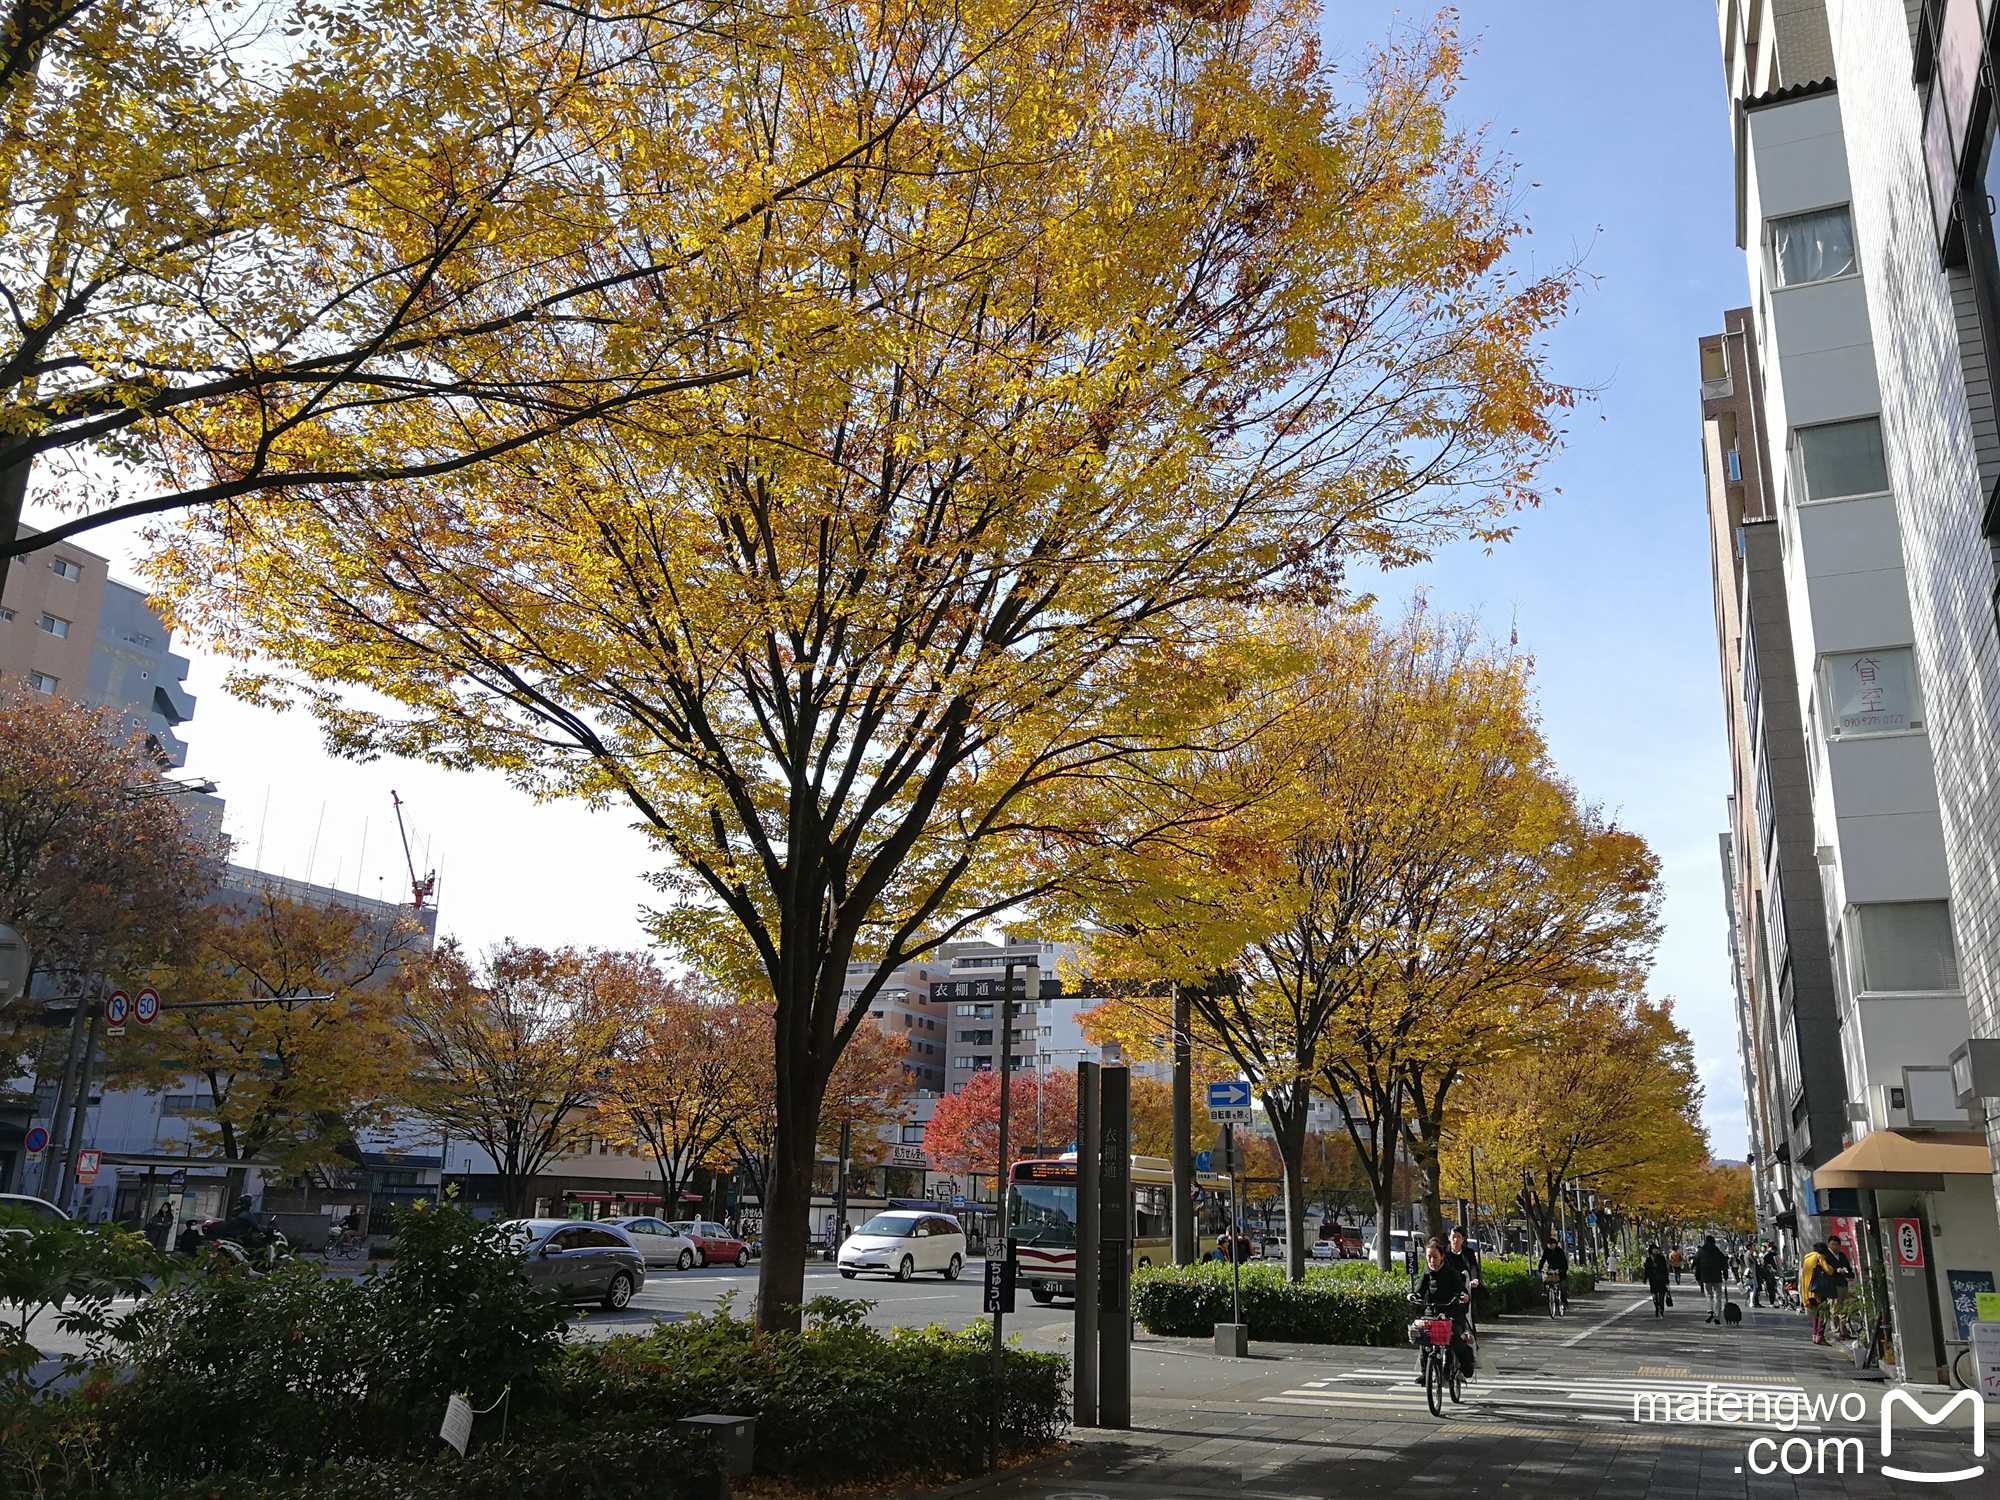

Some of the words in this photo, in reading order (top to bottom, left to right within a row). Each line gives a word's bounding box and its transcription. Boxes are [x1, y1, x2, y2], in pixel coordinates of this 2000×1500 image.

[1850, 657, 1885, 713] 貸室
[140, 998, 154, 1014] 50
[935, 982, 989, 996] 衣棚通
[1210, 1109, 1249, 1120] 自転車を除く
[1104, 1127, 1117, 1178] 衣棚通
[1902, 1225, 1915, 1260] たばこ
[988, 1261, 1002, 1312] ちゅうい
